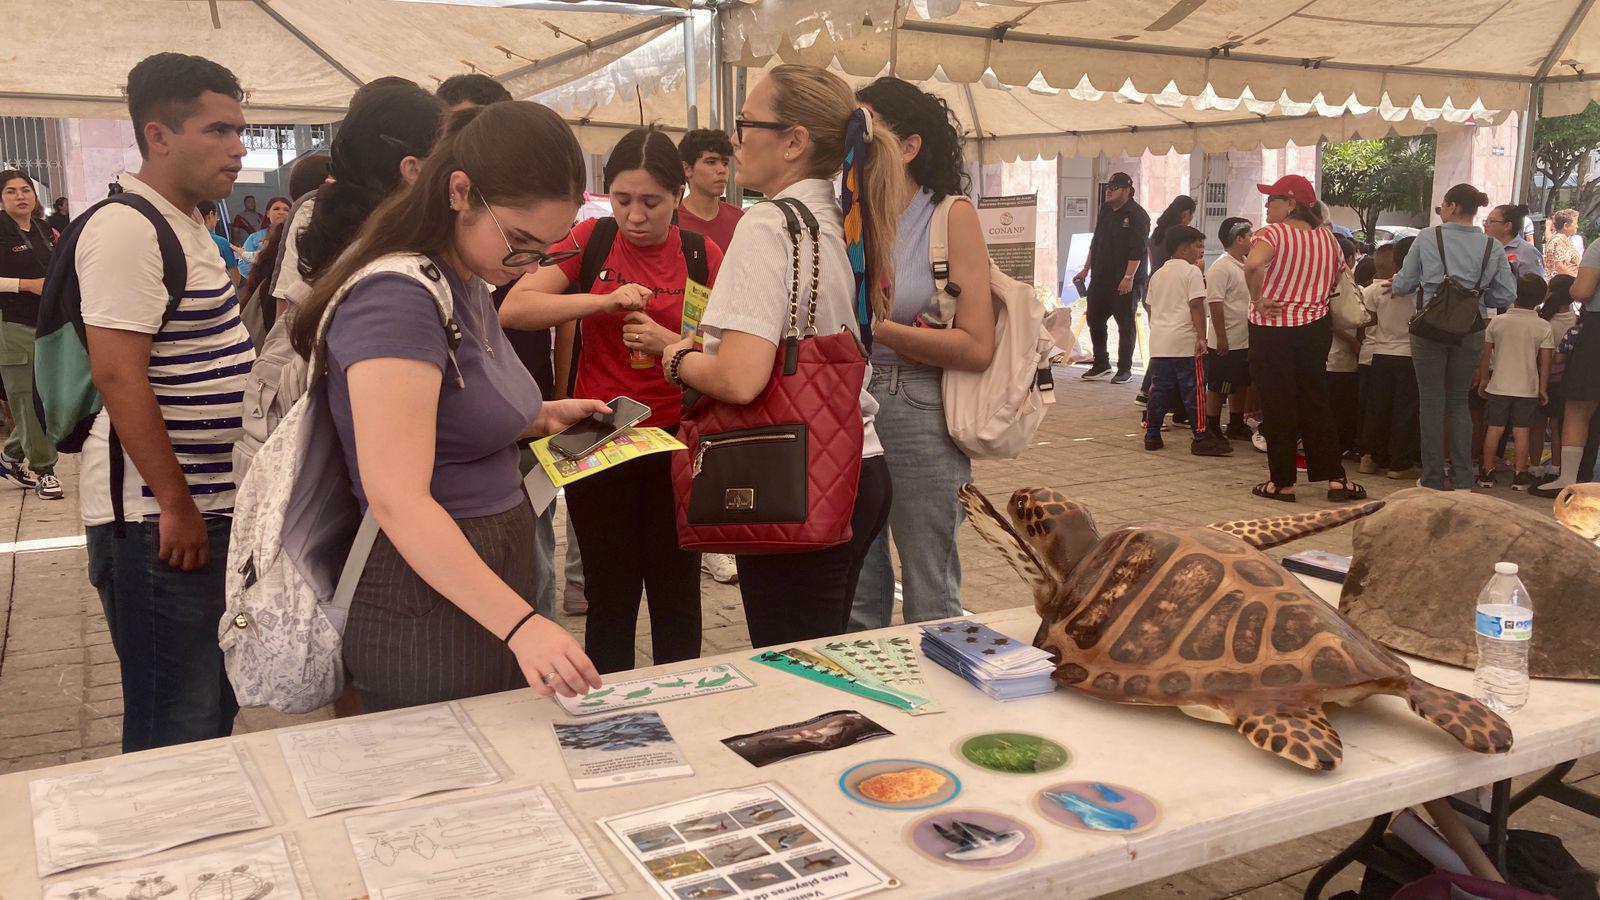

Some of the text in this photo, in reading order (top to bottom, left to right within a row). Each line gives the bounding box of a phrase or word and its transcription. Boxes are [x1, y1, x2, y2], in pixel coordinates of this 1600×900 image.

[989, 227, 1025, 235] CONANP
[821, 871, 848, 881] Aves
[770, 878, 820, 896] playeras
